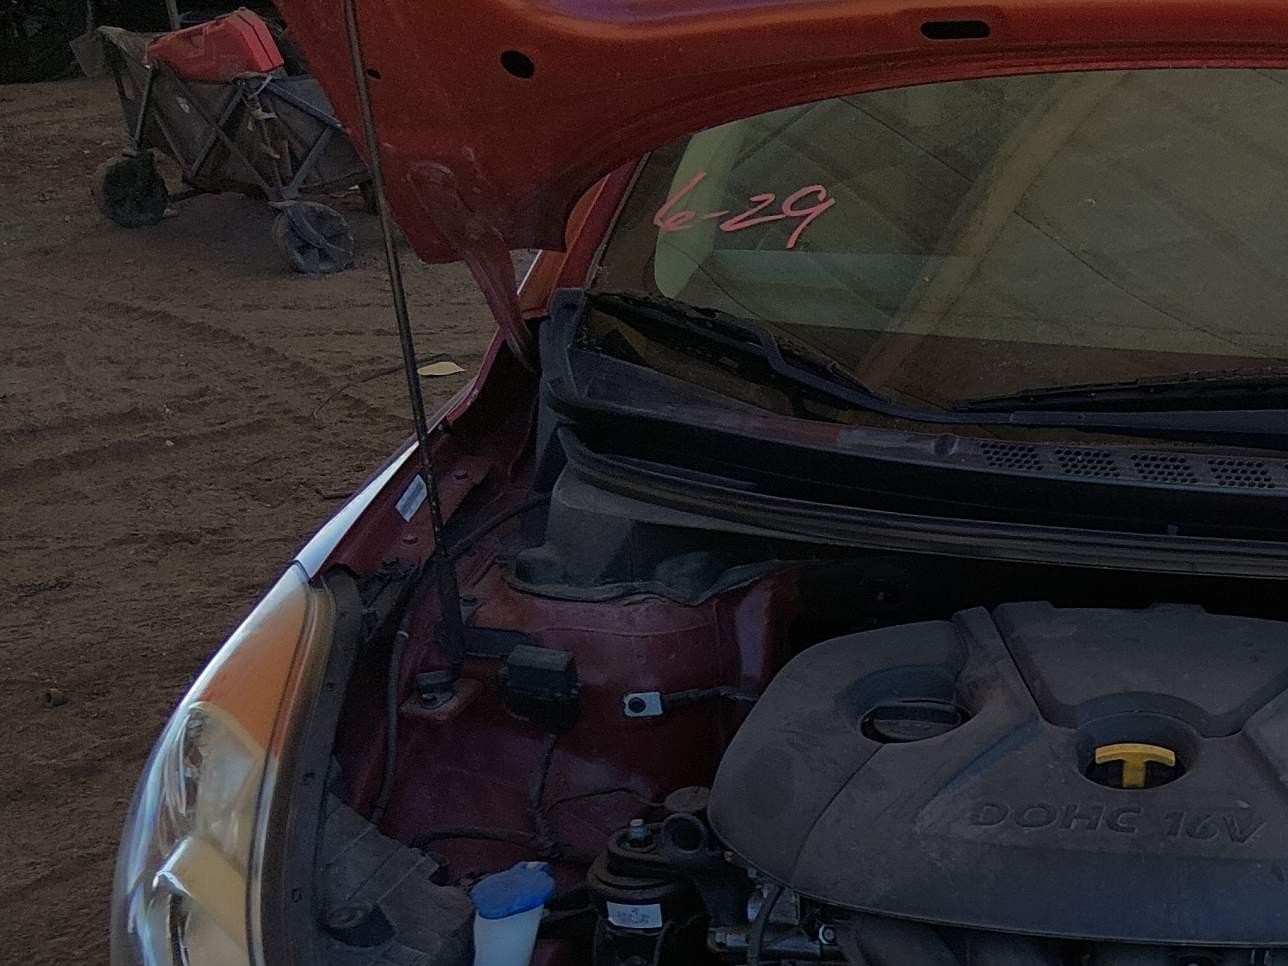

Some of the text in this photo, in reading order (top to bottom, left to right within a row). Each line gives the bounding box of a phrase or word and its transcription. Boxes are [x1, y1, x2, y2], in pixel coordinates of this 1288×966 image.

[653, 172, 836, 249] 6-29
[968, 803, 1267, 844] DOHC 16V
